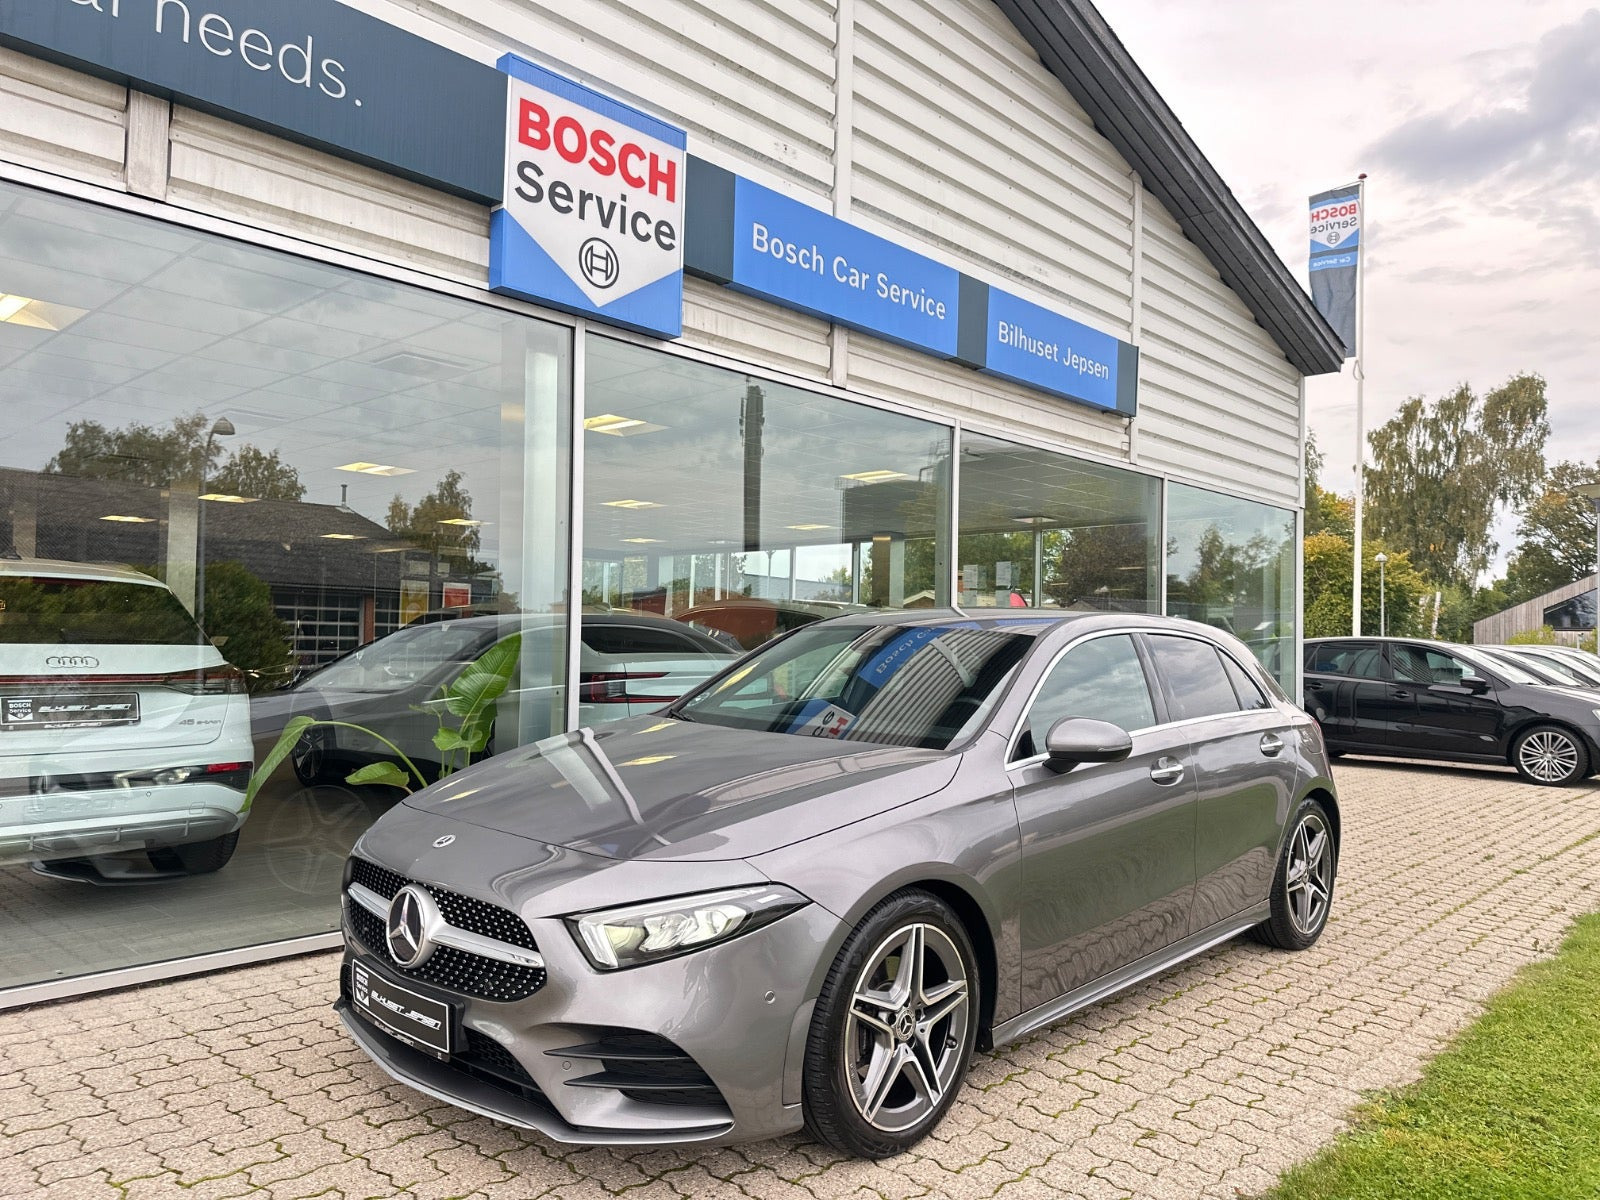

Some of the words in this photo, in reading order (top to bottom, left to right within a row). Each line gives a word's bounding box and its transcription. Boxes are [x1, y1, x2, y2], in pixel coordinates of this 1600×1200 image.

[155, 0, 362, 107] needs.
[518, 97, 676, 203] BOSCH
[514, 160, 676, 251] Service
[752, 222, 824, 275] Bosch
[833, 255, 870, 291] Car
[876, 276, 946, 320] Service
[998, 320, 1059, 363] Bilhuset
[1063, 347, 1109, 381] Jepsen
